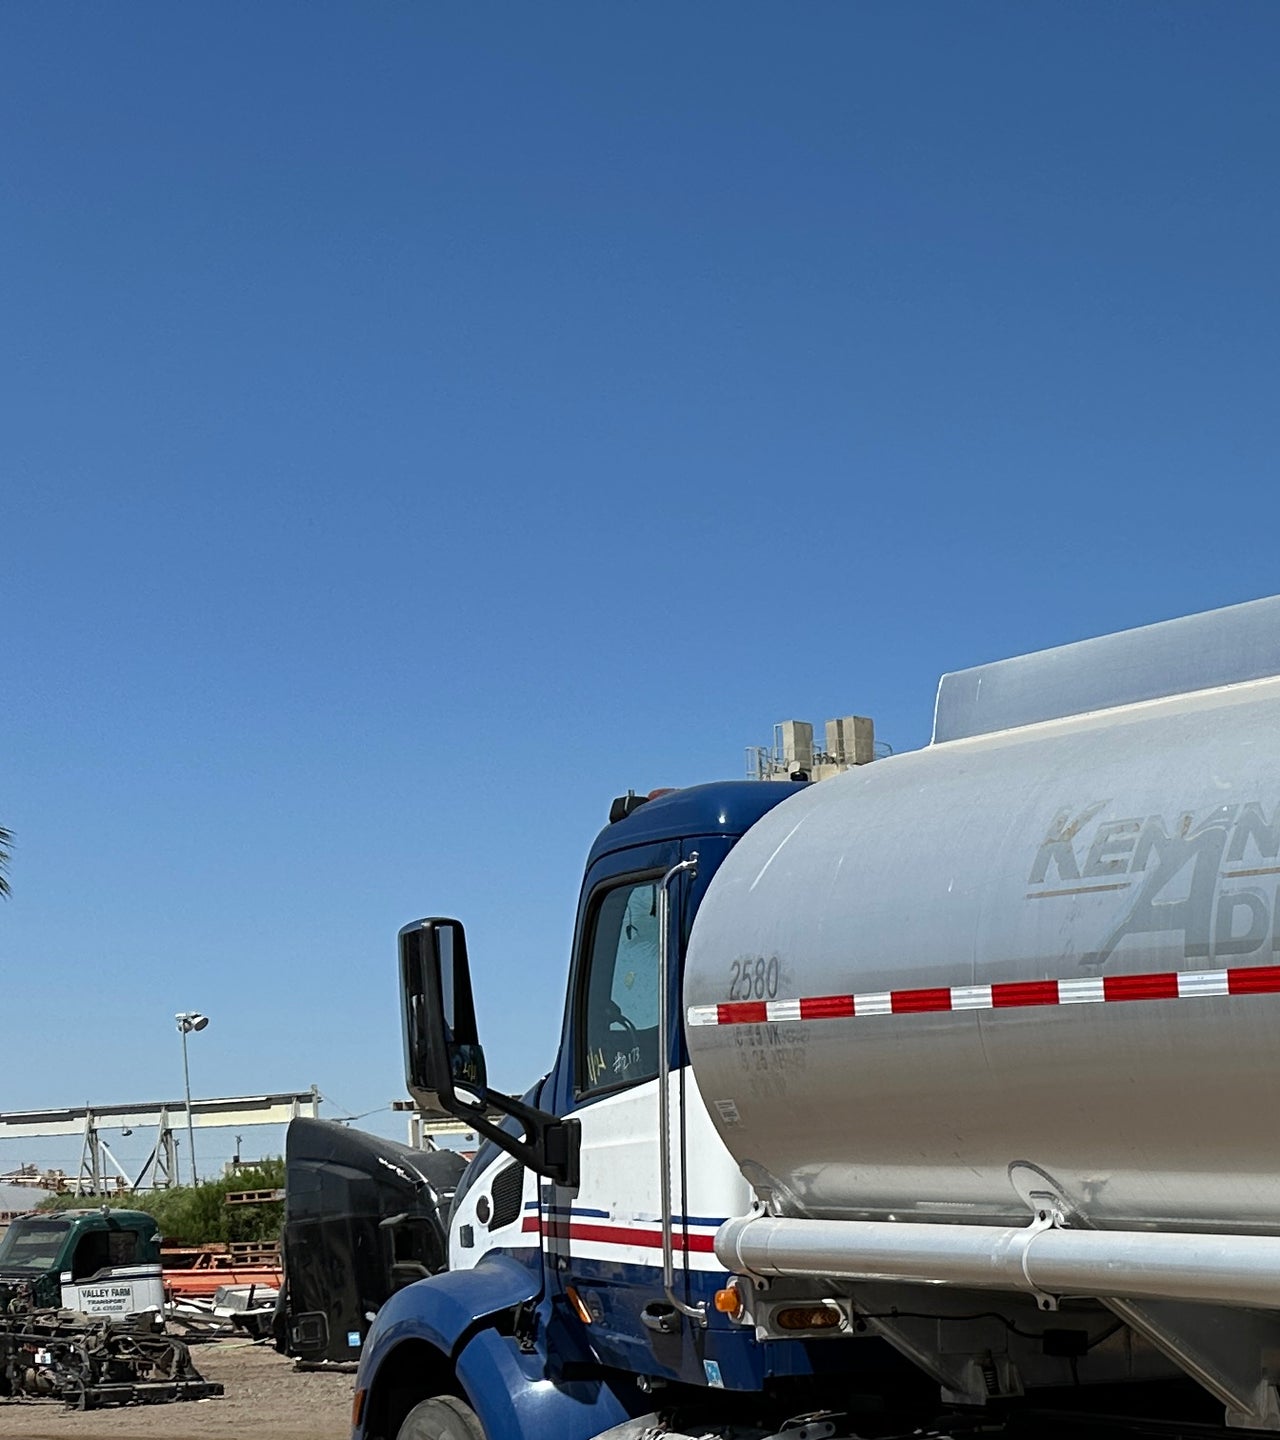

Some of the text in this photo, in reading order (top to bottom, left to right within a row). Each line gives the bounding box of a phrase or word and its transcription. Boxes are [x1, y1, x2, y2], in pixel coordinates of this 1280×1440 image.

[730, 956, 779, 1001] 2580
[82, 1288, 131, 1298] VALLEY FARM
